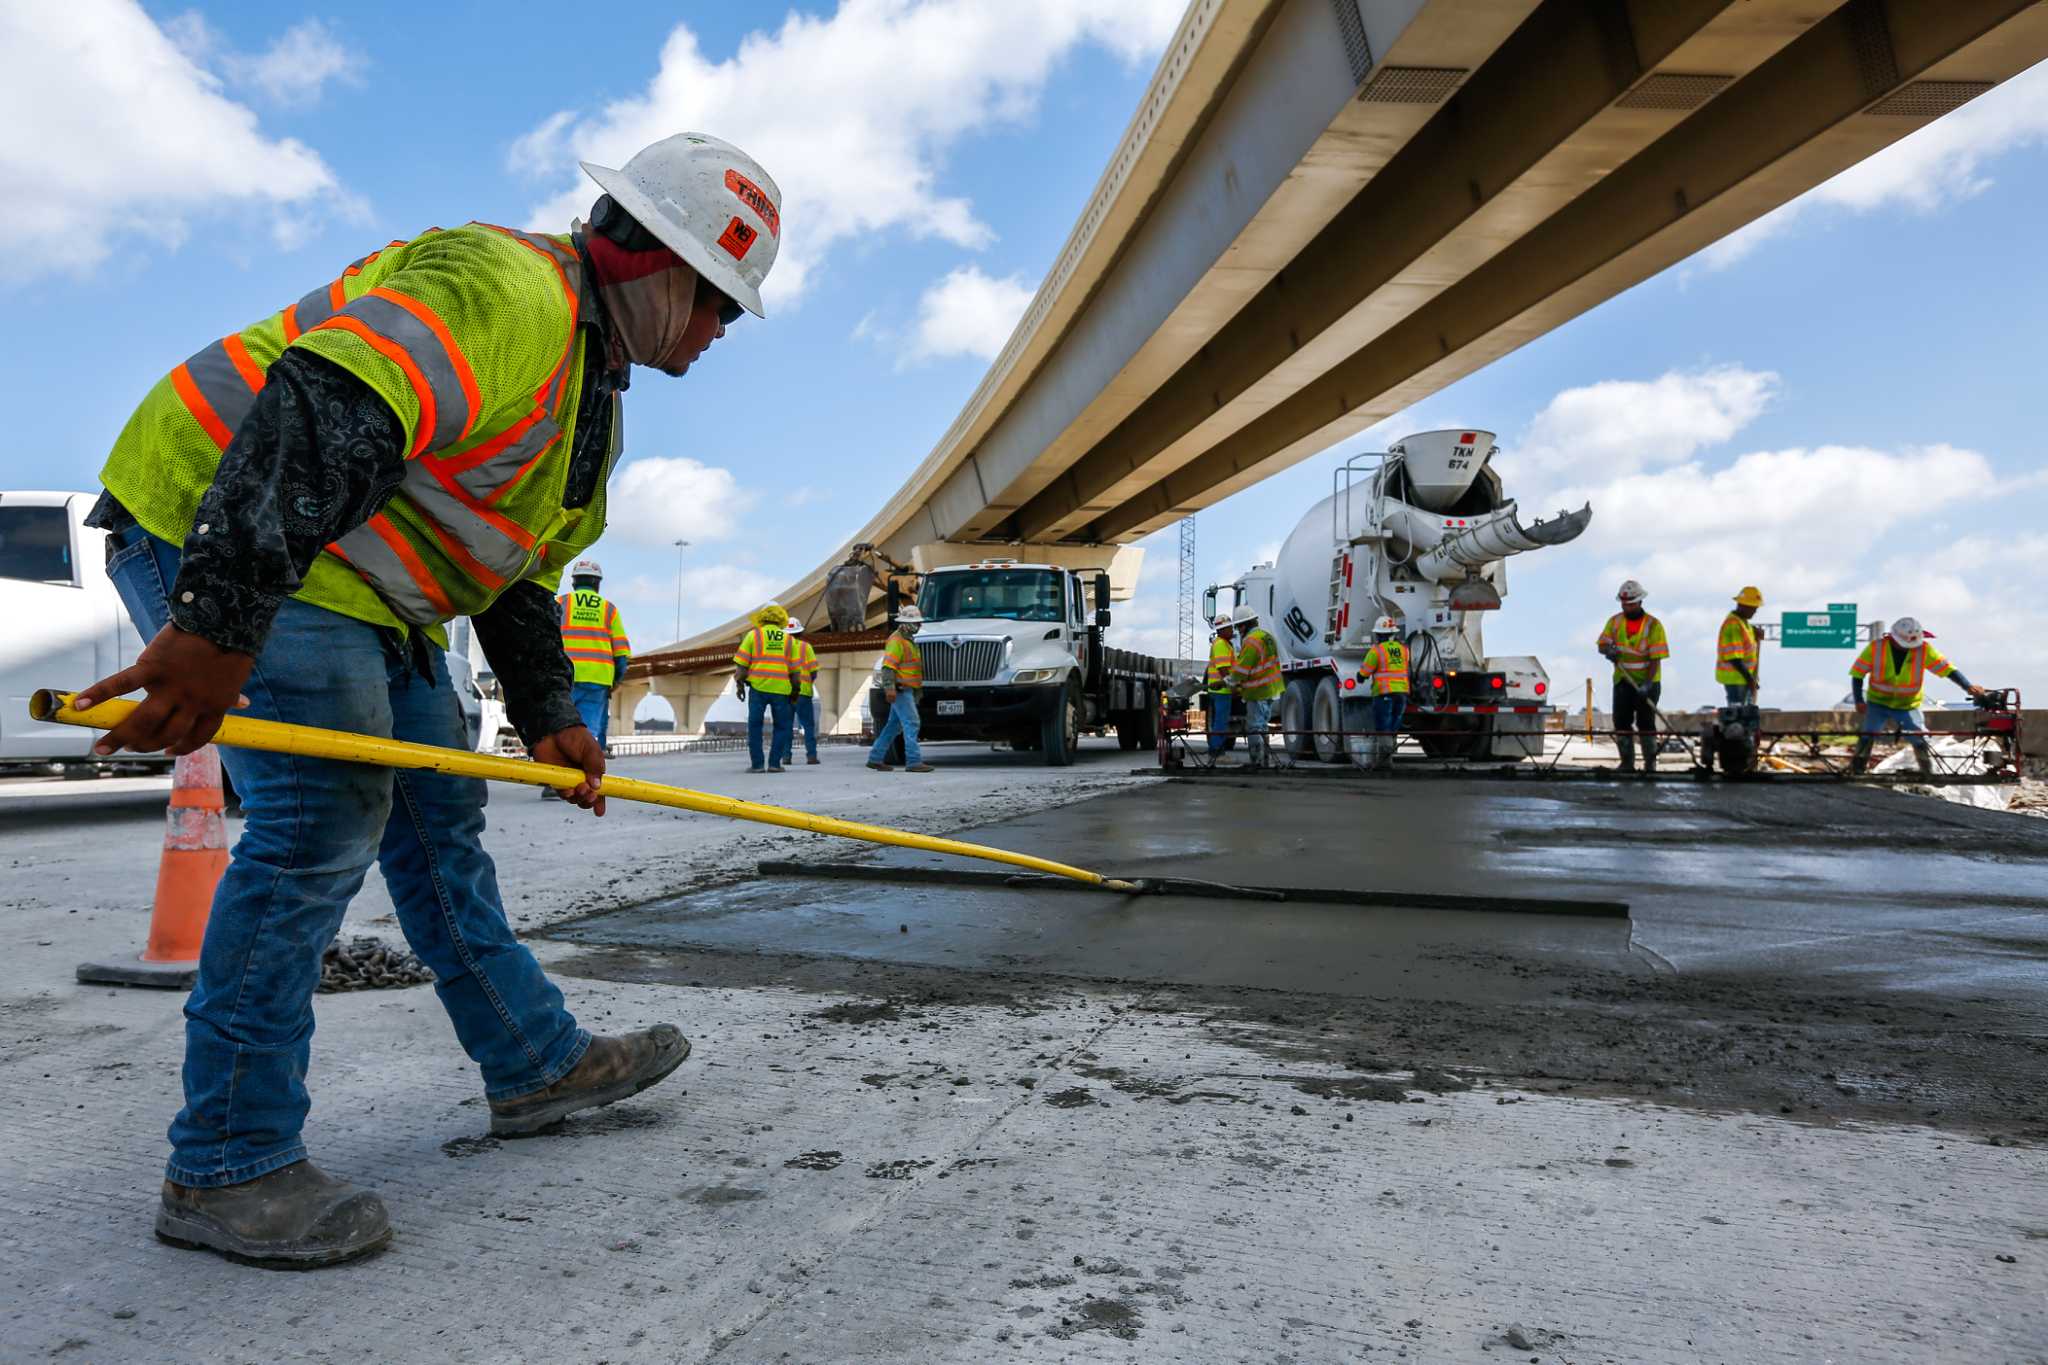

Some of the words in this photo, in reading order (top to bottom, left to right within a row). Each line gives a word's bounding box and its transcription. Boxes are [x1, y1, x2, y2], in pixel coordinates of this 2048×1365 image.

[734, 220, 752, 242] WB
[575, 593, 602, 608] WB
[1283, 605, 1313, 643] WB
[766, 629, 784, 641] WB
